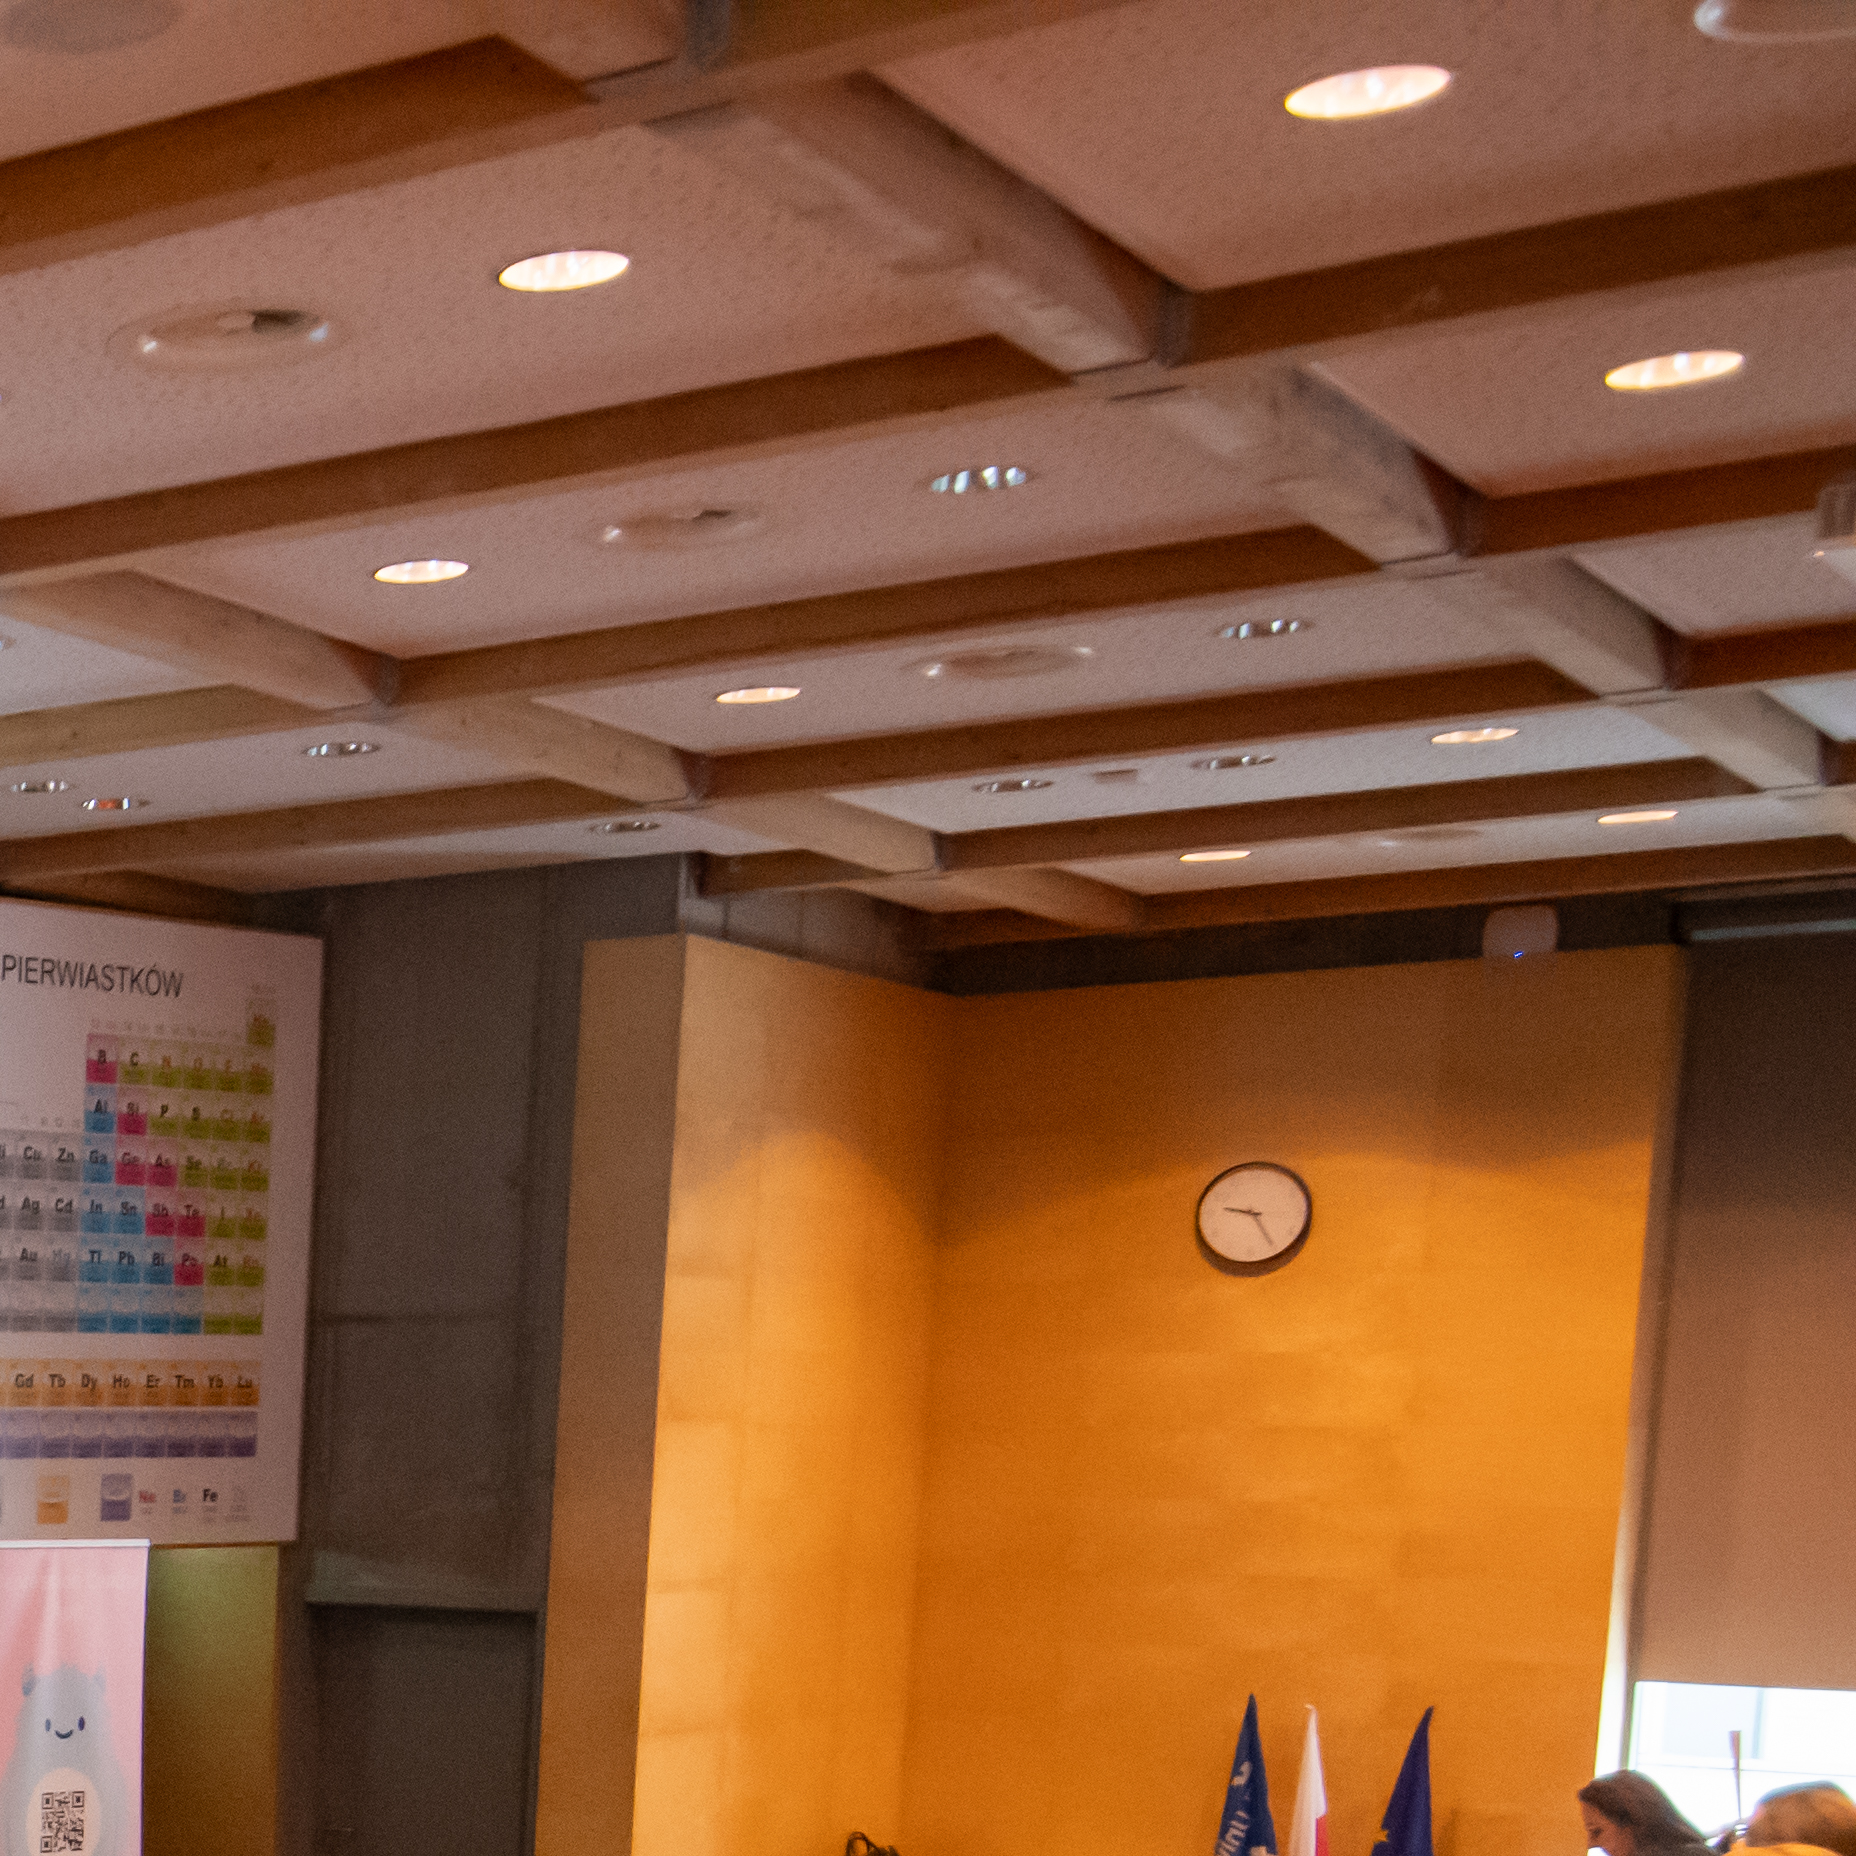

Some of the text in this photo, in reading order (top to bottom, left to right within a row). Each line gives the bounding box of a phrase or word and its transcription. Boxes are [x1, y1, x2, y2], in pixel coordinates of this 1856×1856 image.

[1, 953, 184, 998] PIERWIASTKÓW
[57, 1147, 75, 1164] Zn
[21, 1196, 40, 1215] Ag
[55, 1198, 73, 1213] Cd
[19, 1247, 38, 1262] Au
[15, 1373, 34, 1389] Gd
[49, 1373, 66, 1388] Tb
[81, 1373, 97, 1393] Dy
[202, 1488, 218, 1503] Fe
